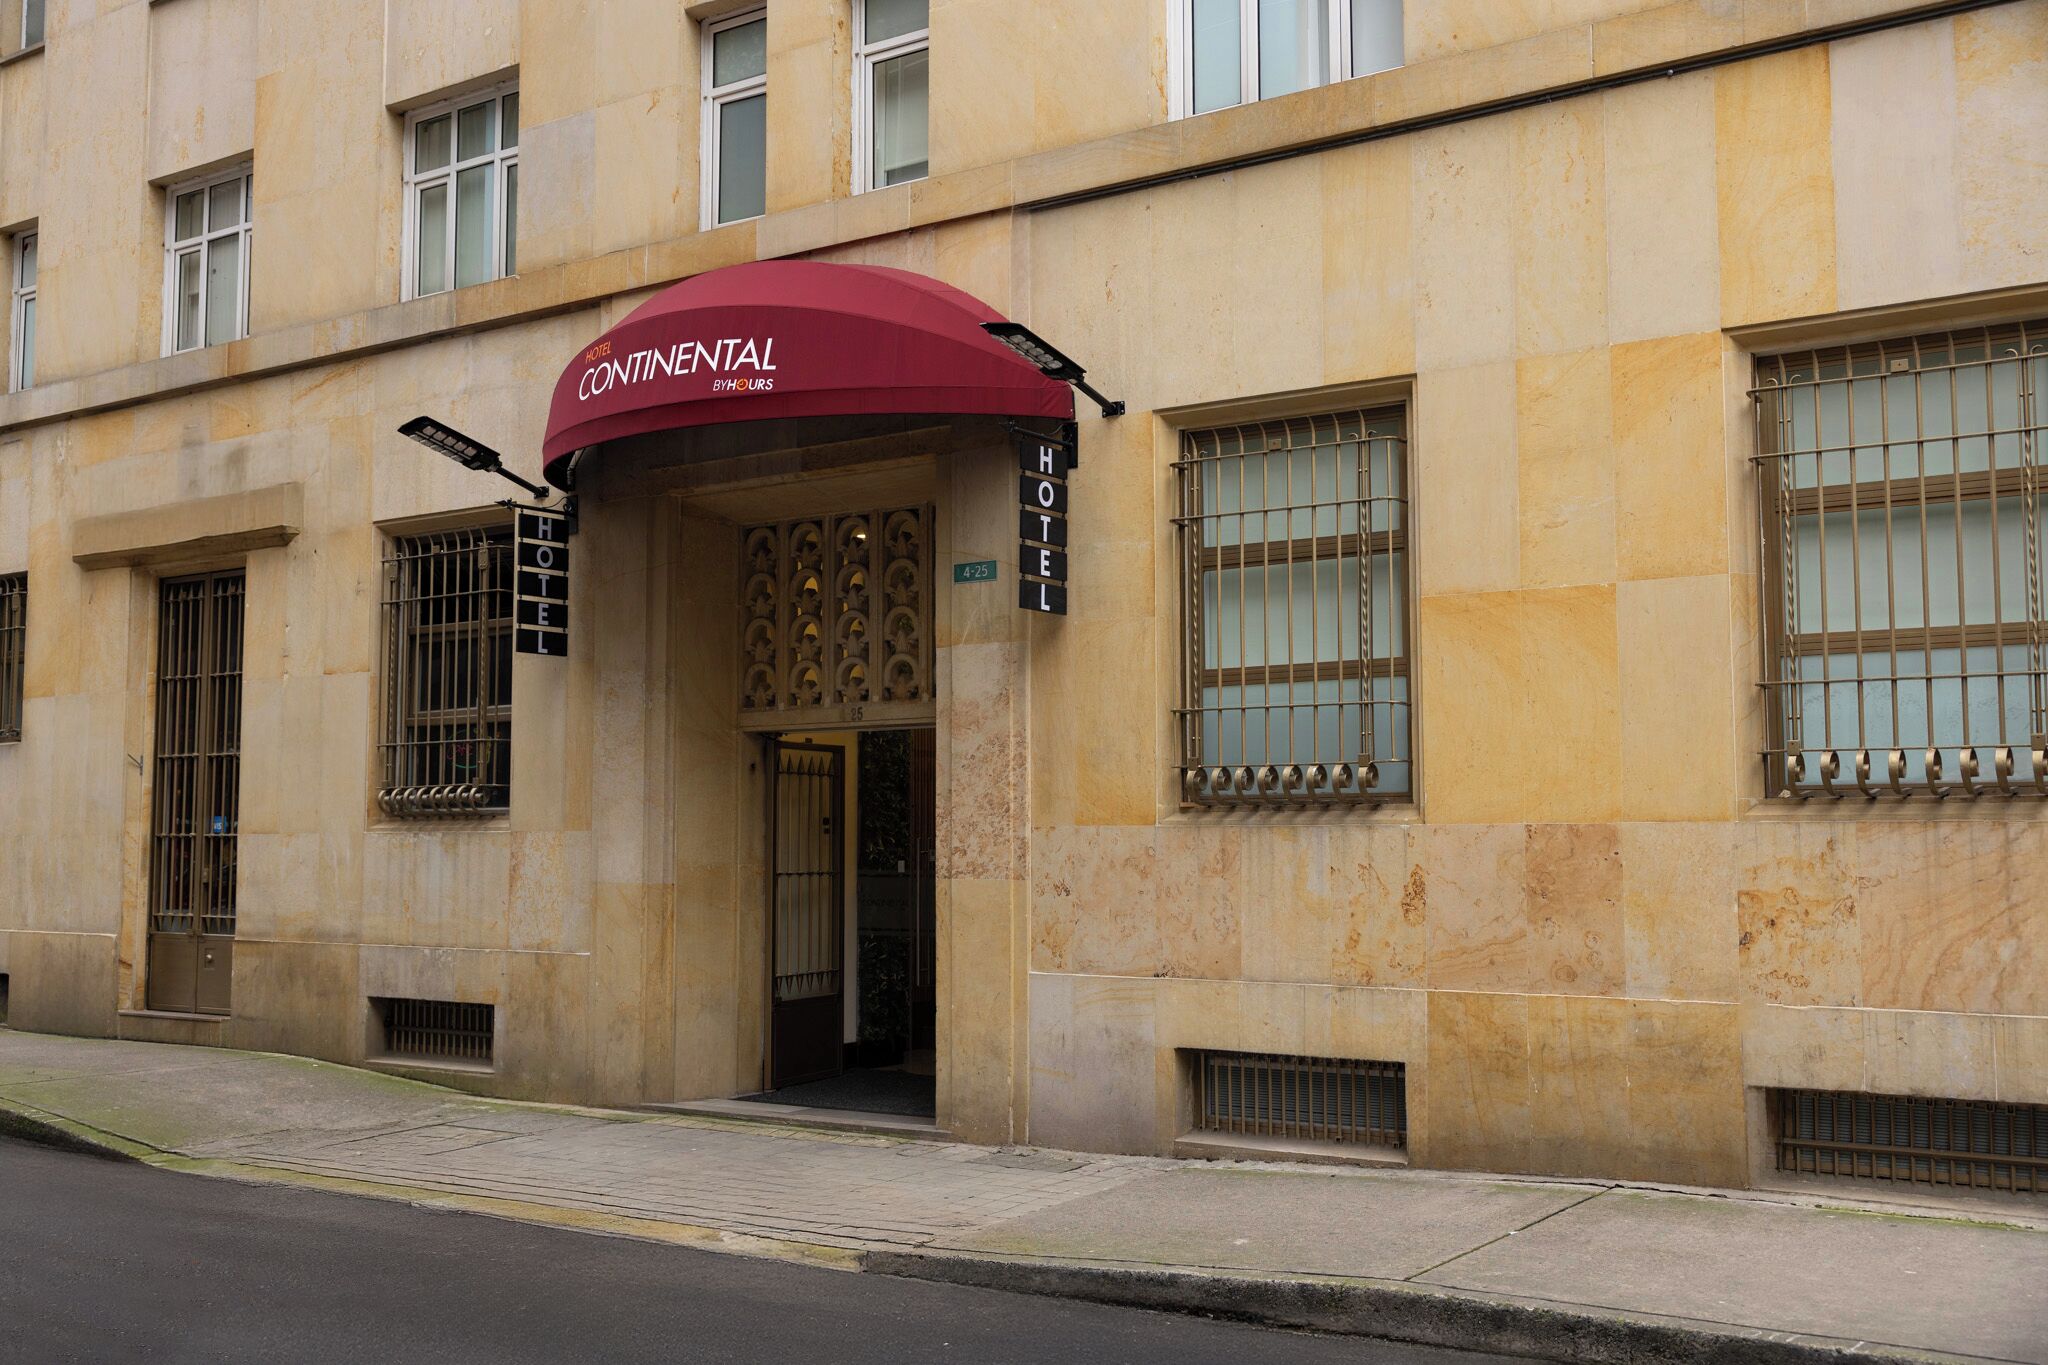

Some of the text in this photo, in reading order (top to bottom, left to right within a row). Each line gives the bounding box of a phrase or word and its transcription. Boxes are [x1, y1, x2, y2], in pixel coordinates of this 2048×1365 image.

[578, 337, 777, 401] CONTINENTAL
[585, 341, 612, 364] HOTEL
[1038, 446, 1054, 611] HOTEL
[536, 516, 554, 654] HOTEL
[963, 564, 988, 578] 4-25
[850, 706, 863, 721] 25
